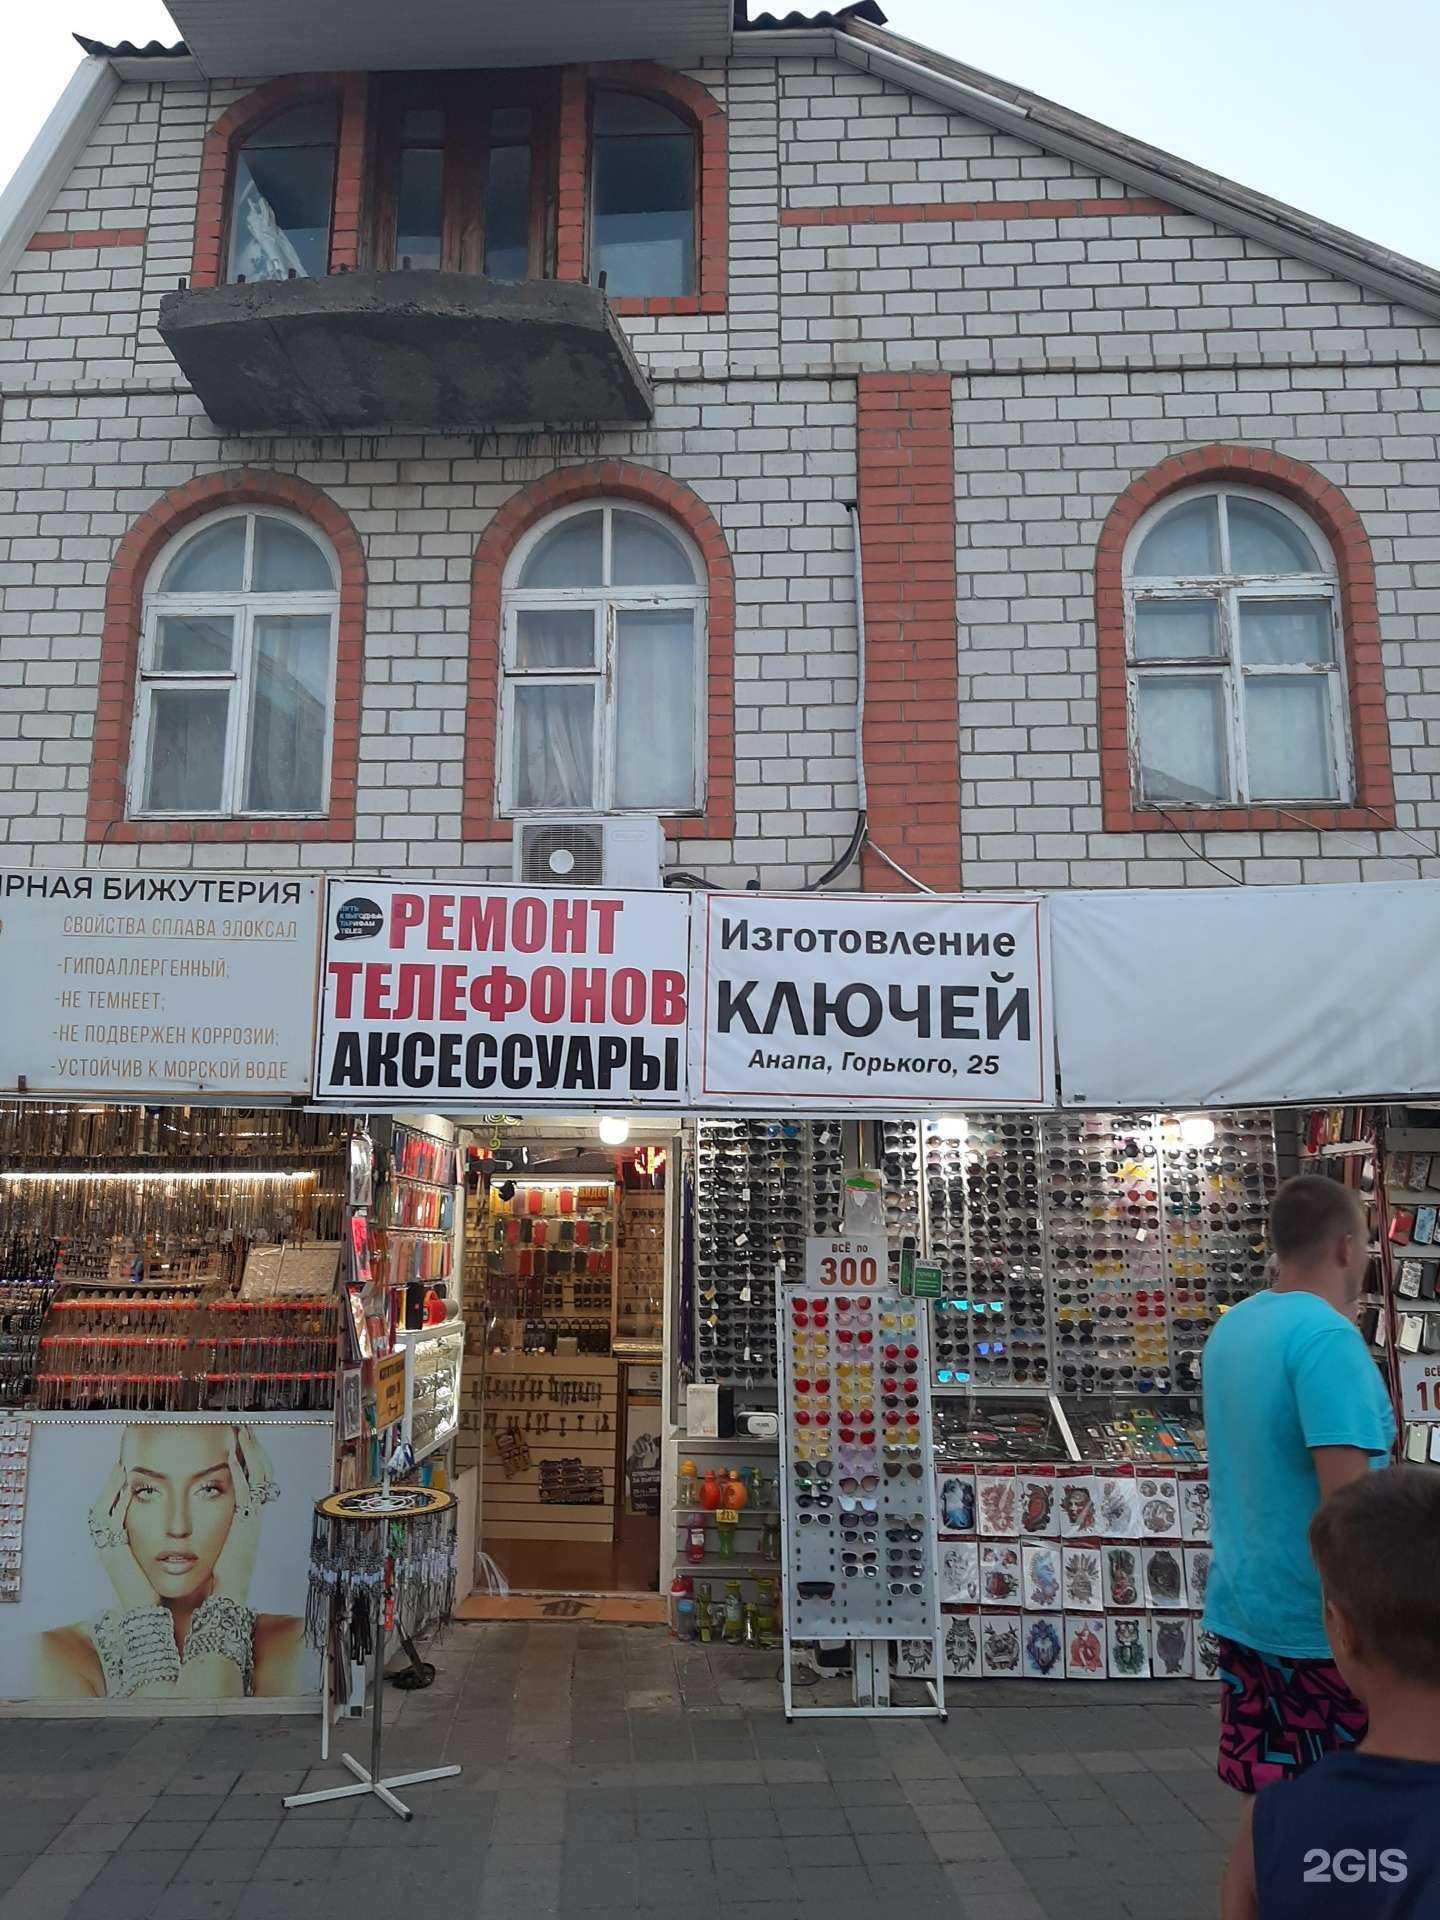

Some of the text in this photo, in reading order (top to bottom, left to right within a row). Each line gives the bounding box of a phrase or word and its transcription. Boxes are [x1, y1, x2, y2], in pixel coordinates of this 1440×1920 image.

[0, 875, 300, 904] РНАЯ БИЖУТЕРИЯ
[63, 914, 146, 935] СВОЙСТВА
[152, 918, 216, 937] СПЛАВА
[389, 893, 624, 954] РЕМОНТ
[721, 918, 1016, 956] Изготовление
[57, 956, 230, 978] -ГИПОАЛЛЕРГЕННЫЙ;
[55, 991, 165, 1011] -НЕ ТЕМНЕЕТ;
[329, 962, 687, 1025] ТЕЛЕФОНОВ
[717, 971, 1031, 1041] КЛЮЧЕЙ
[53, 1024, 279, 1046] -НЕ ПОДВЕРЖЕН КОРРОЗИИ;
[51, 1056, 289, 1081] -УСТОЙЧИВ К МОРСКОЙ ВОДЕ
[329, 1032, 679, 1091] АКСЕССУАРЫ
[748, 1049, 999, 1077] Анапа, Горького, 25
[832, 1241, 851, 1253] ВСЁ
[820, 1257, 877, 1286] 300
